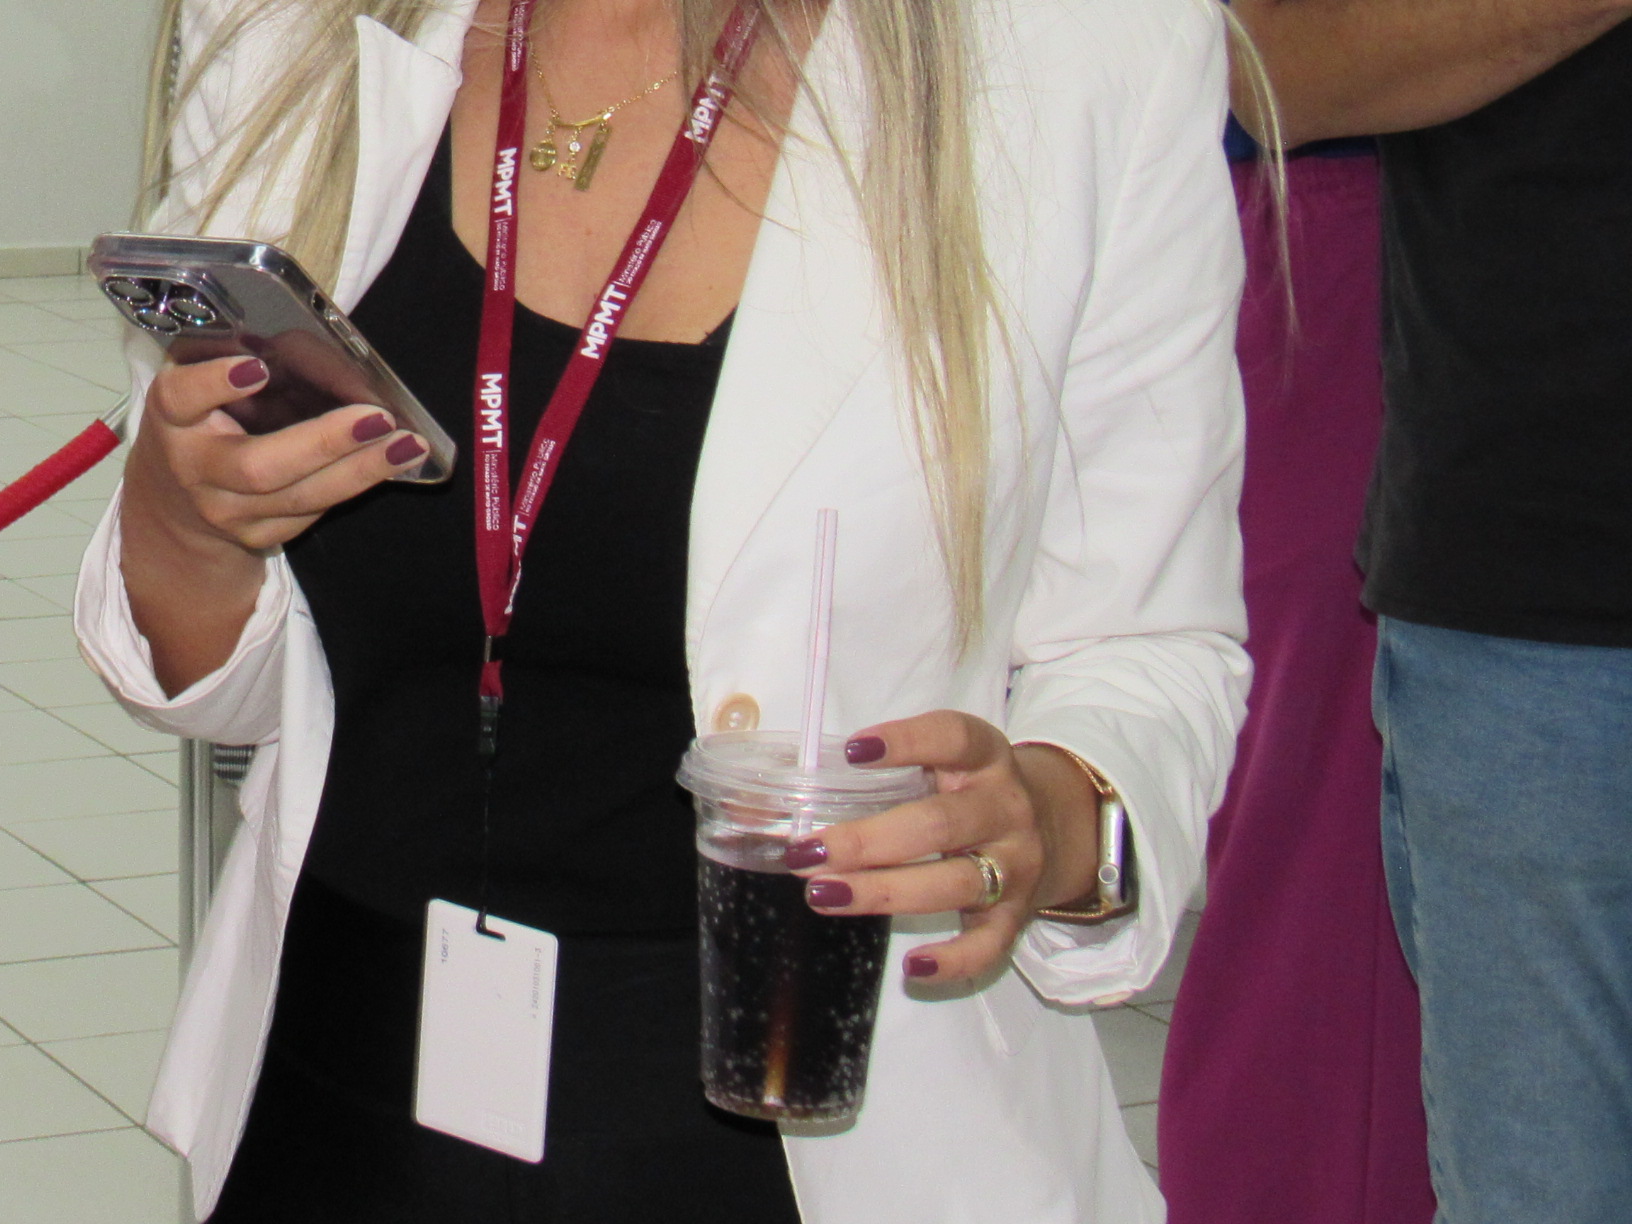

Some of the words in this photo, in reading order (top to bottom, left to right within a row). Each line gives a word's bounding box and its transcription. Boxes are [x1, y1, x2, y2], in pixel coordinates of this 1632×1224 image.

[493, 147, 518, 216] MPMT
[580, 284, 627, 359] MPMT
[480, 373, 503, 448] MPMT
